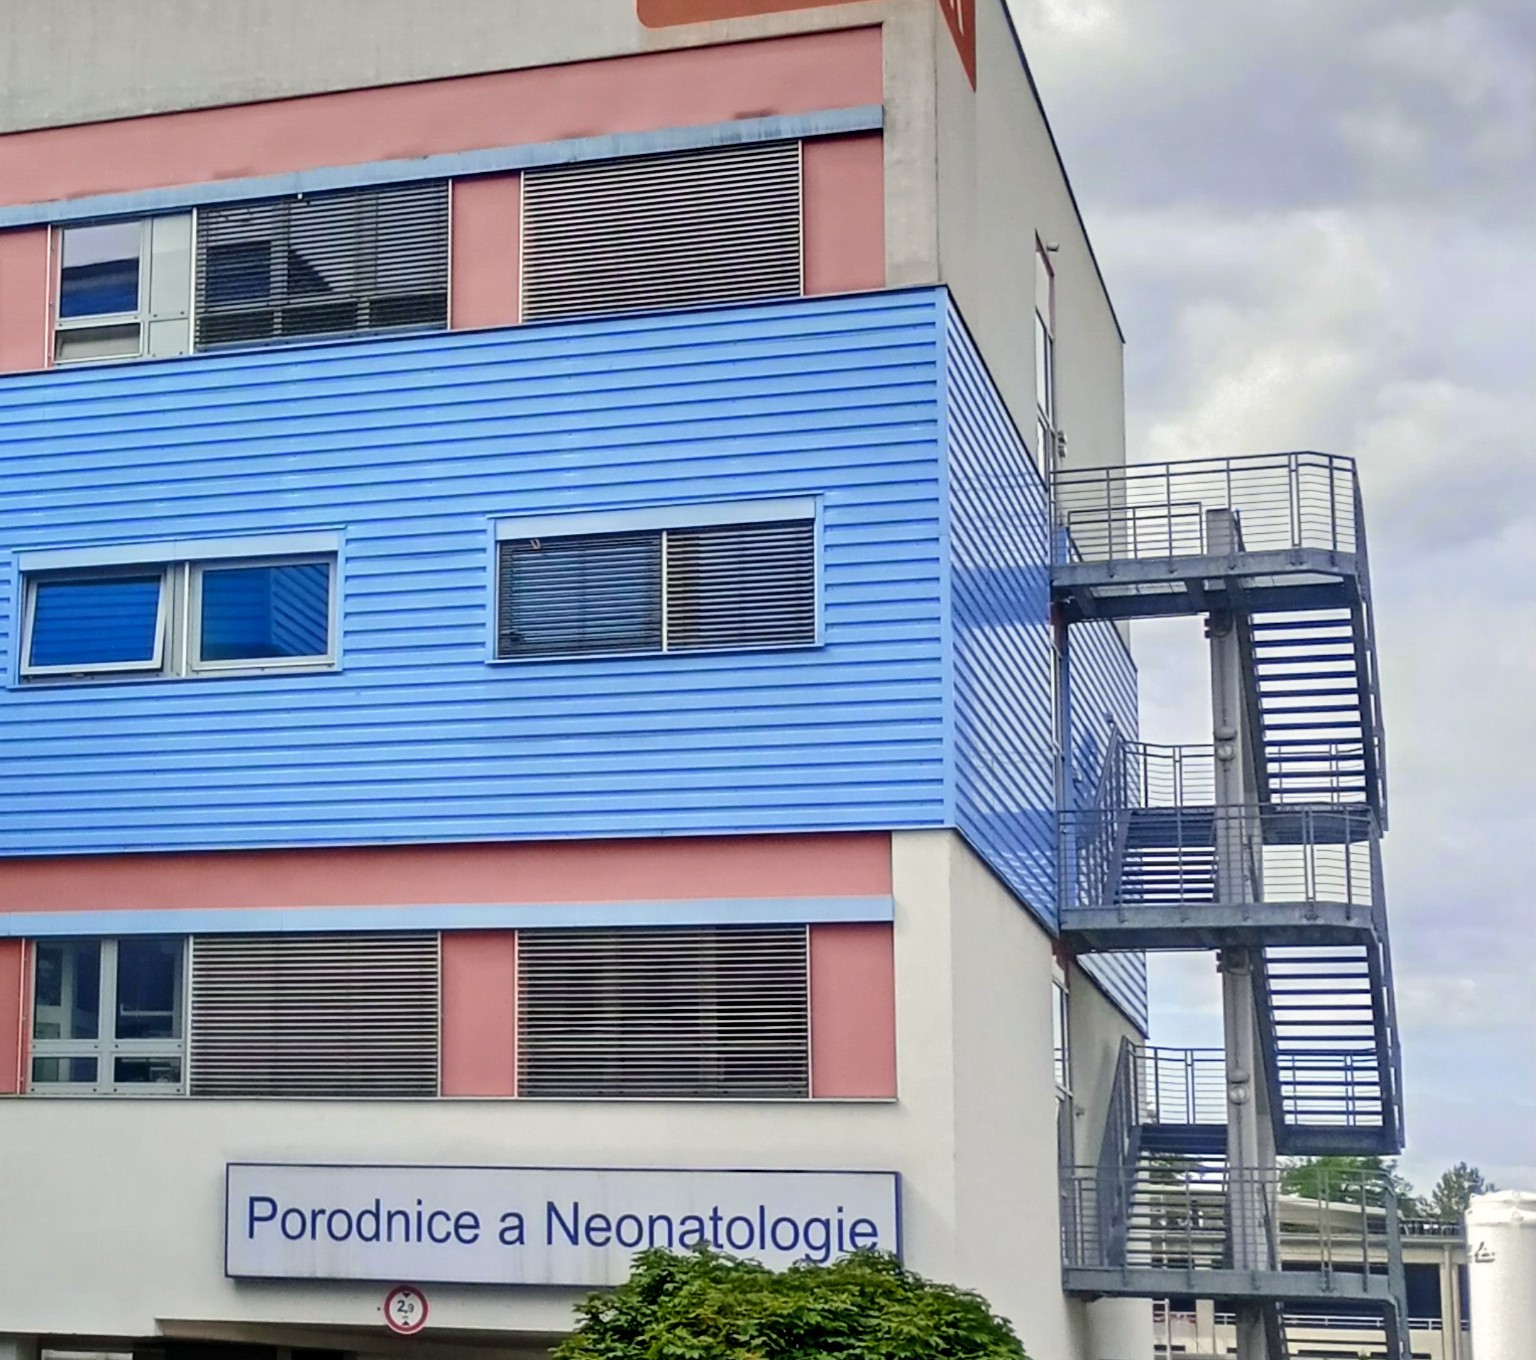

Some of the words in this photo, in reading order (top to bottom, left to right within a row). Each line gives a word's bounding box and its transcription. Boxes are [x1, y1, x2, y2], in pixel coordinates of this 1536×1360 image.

[248, 1196, 481, 1245] Porodnice
[498, 1209, 526, 1246] a
[545, 1200, 879, 1265] Neonatologie
